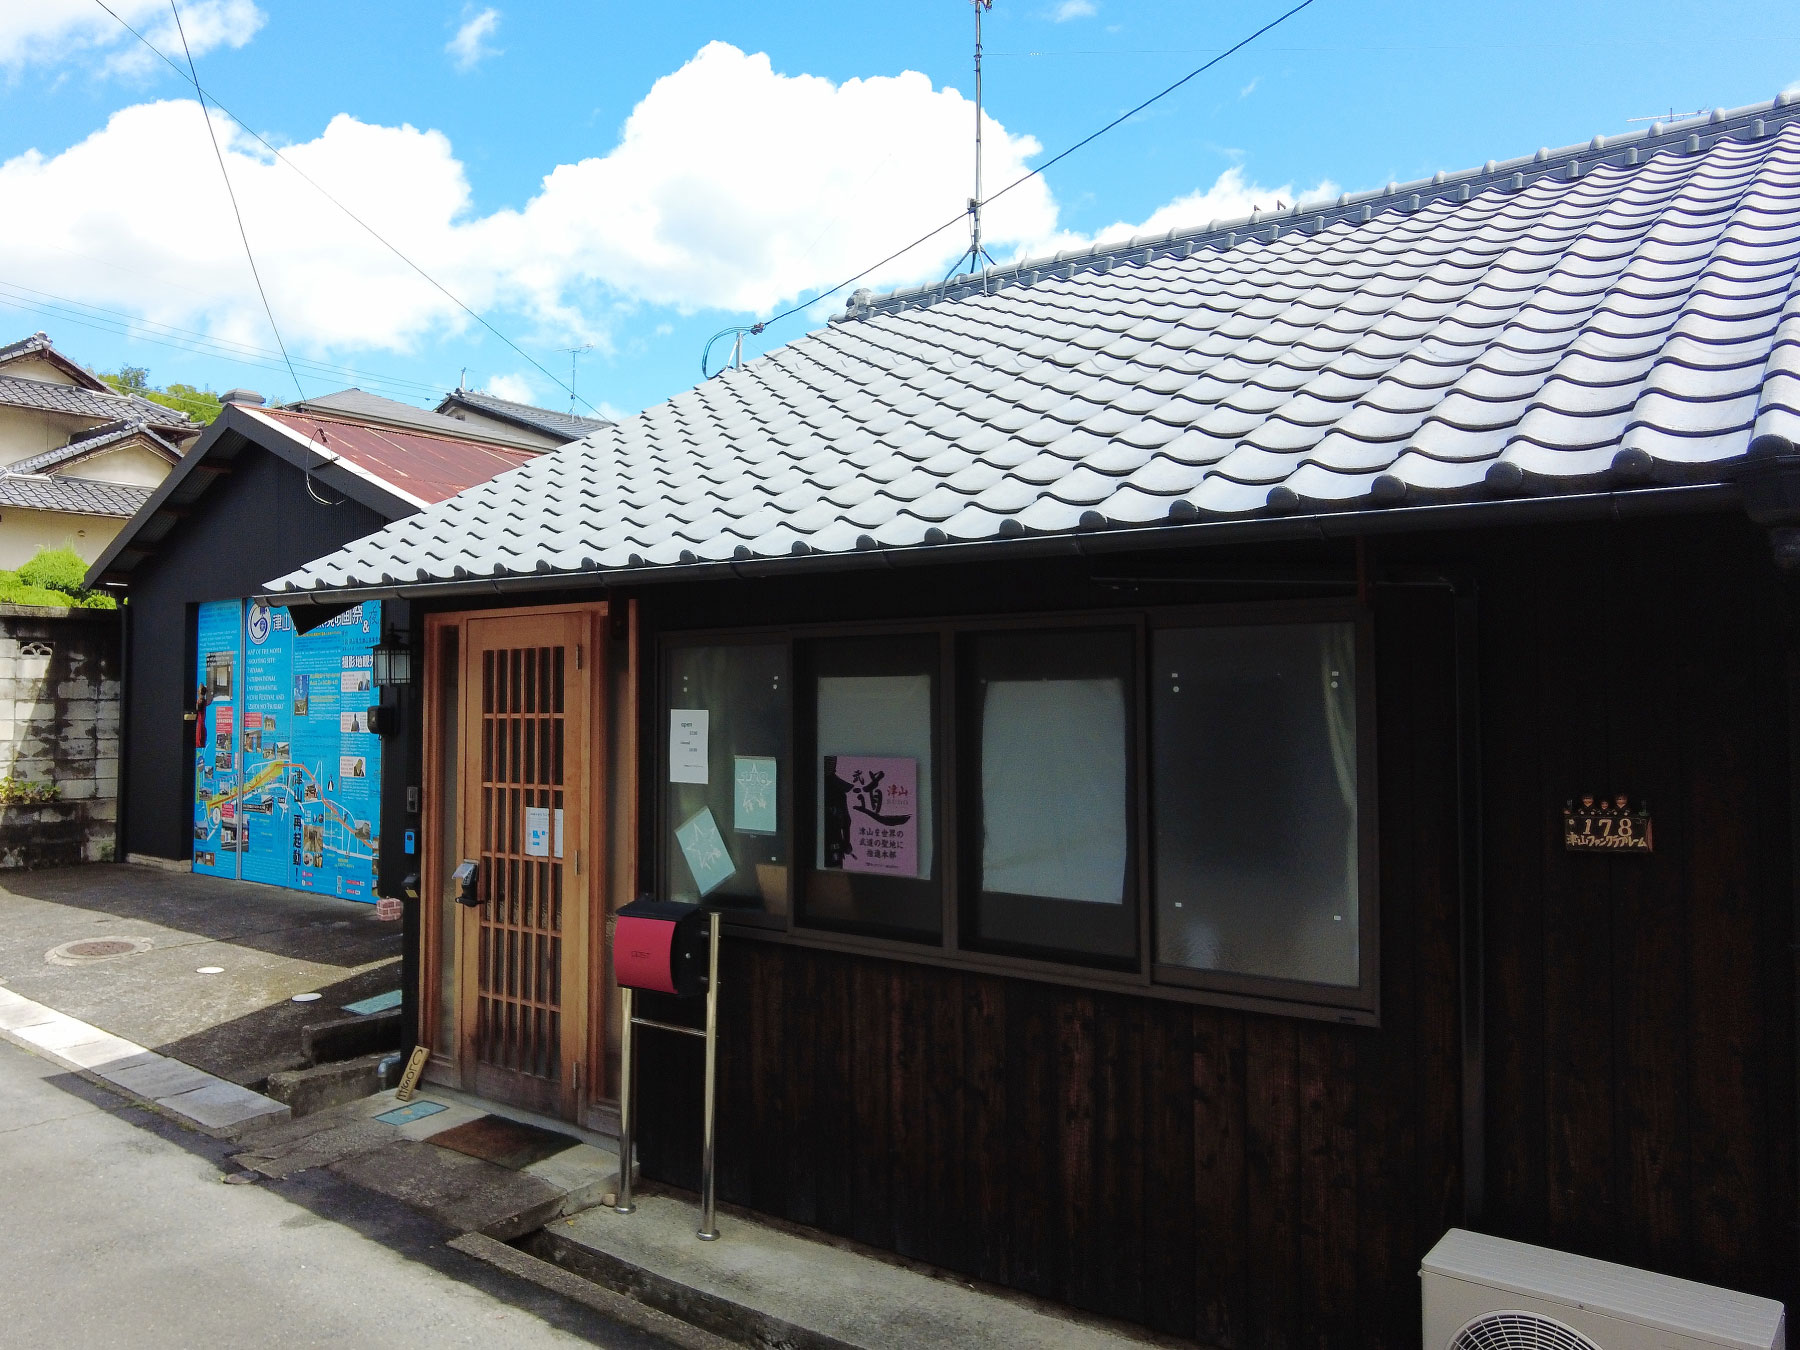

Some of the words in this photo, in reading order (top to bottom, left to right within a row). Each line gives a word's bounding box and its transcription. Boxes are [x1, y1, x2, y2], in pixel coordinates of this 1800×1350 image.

[362, 621, 370, 633] &
[887, 784, 908, 798] 津山
[1582, 818, 1632, 836] 178
